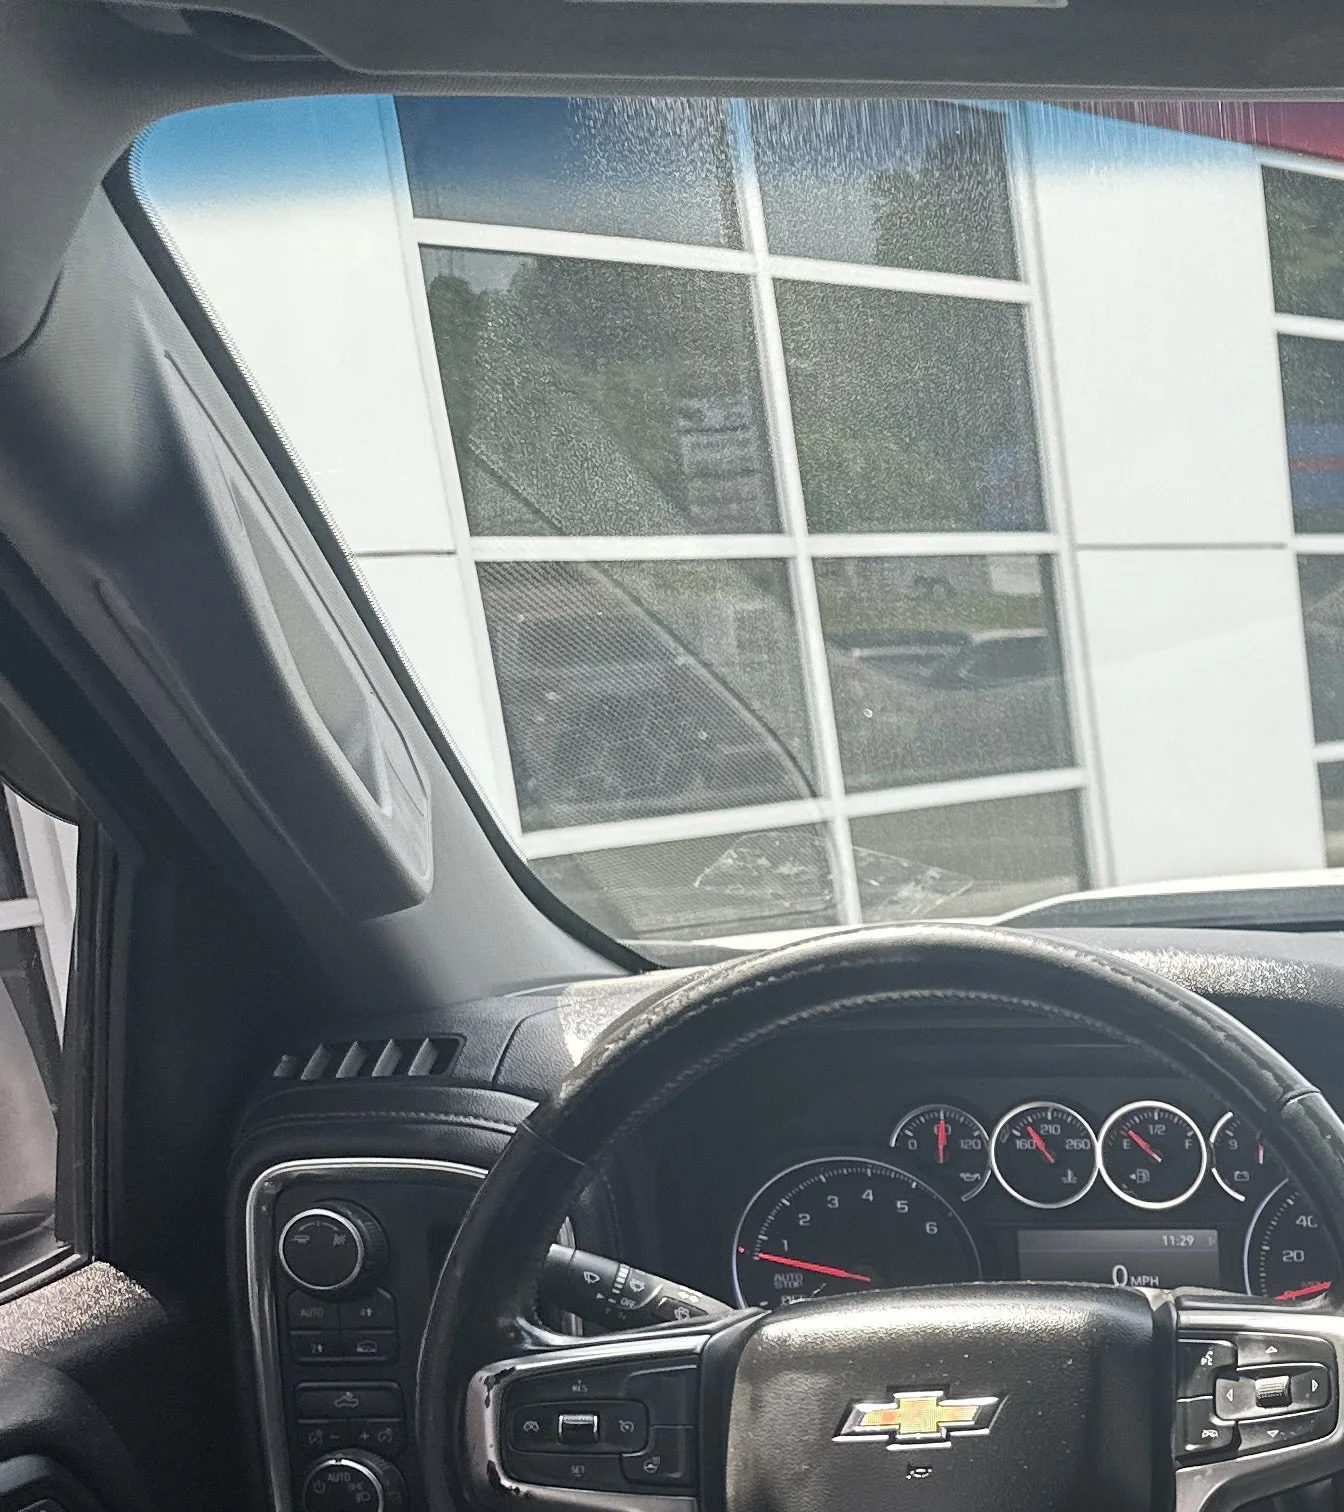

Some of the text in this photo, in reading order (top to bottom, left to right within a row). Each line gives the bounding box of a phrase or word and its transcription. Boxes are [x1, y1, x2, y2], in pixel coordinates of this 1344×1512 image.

[1040, 1124, 1061, 1135] 210
[1148, 1124, 1166, 1136] 1/2
[908, 1139, 918, 1150] 0
[960, 1139, 982, 1150] 120
[1065, 1138, 1091, 1150] 260
[1123, 1138, 1131, 1150] E
[1185, 1138, 1193, 1150] F
[862, 1188, 874, 1202] 4
[827, 1195, 840, 1209] 3
[896, 1200, 909, 1214] 5
[798, 1213, 811, 1227] 2
[925, 1221, 938, 1235] 6
[781, 1239, 789, 1252] 1
[1161, 1234, 1195, 1248] 11:29
[1282, 1249, 1305, 1263] 20
[1112, 1264, 1159, 1287] 0 MPH
[327, 1471, 351, 1483] AUTO
